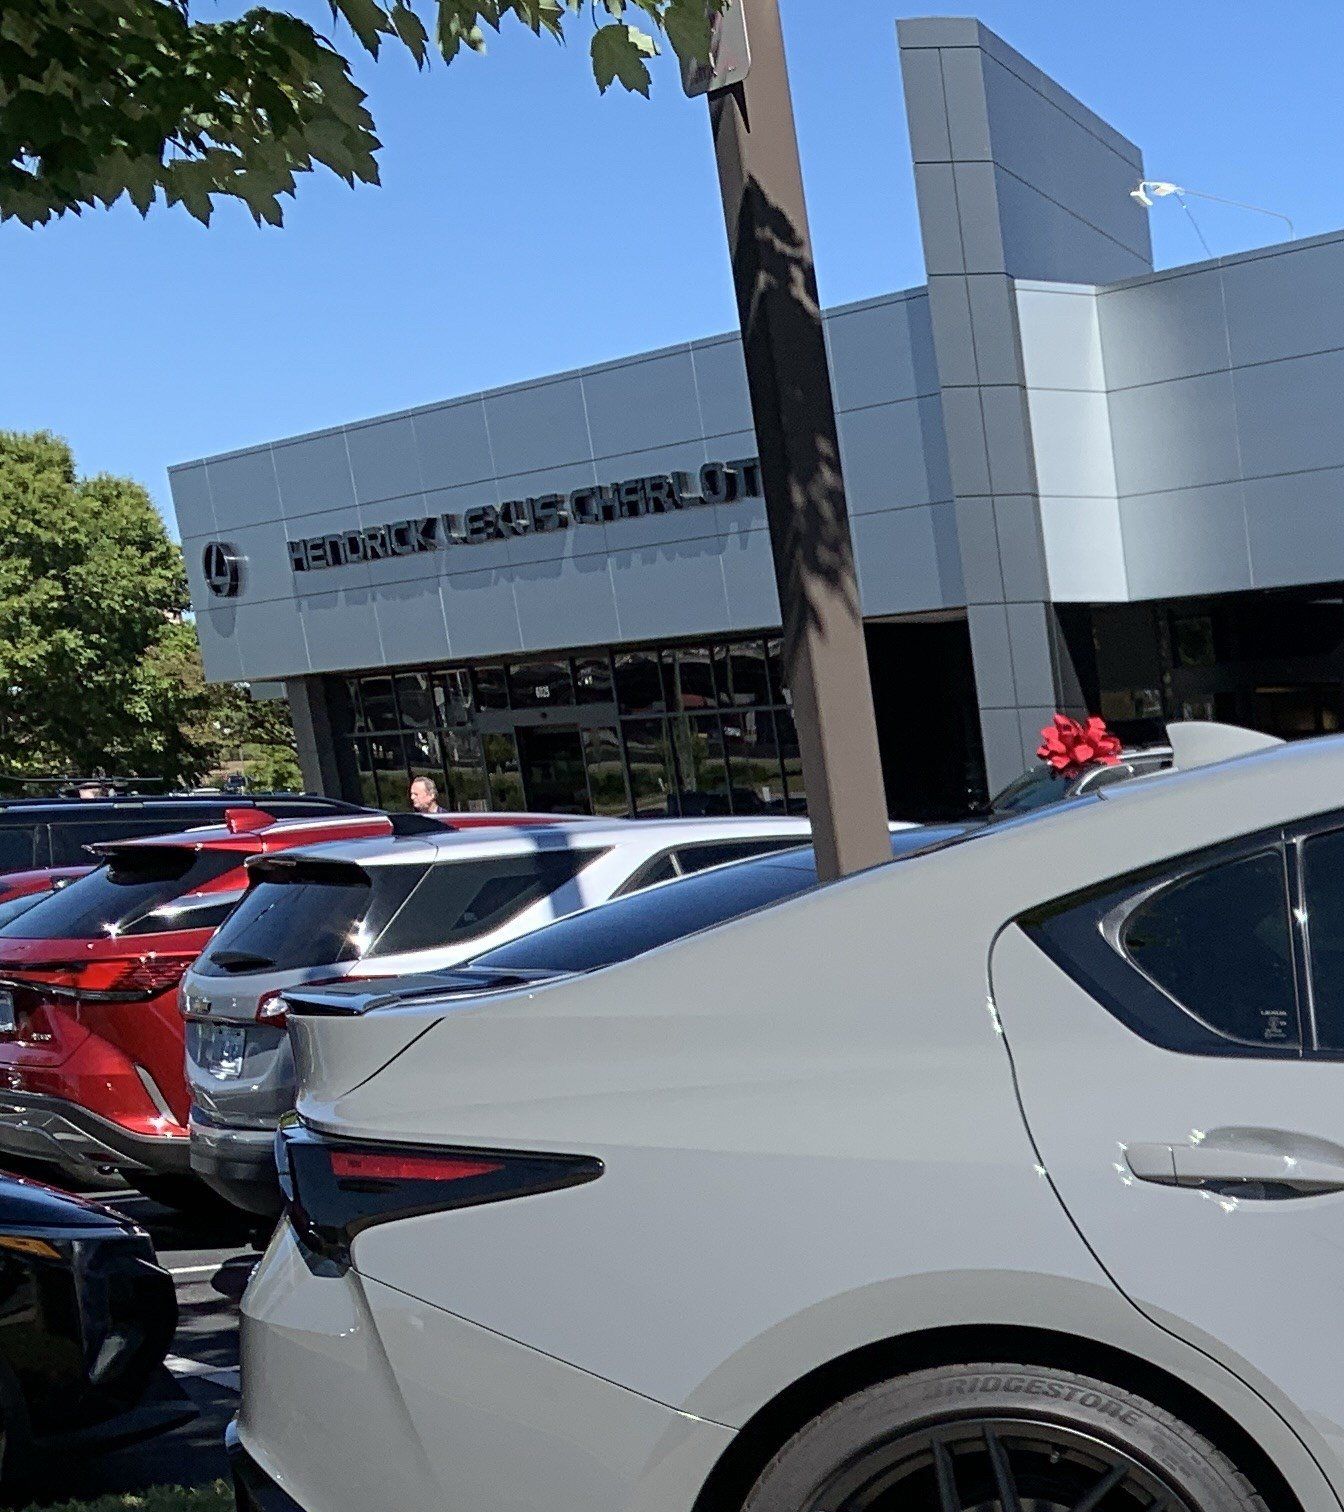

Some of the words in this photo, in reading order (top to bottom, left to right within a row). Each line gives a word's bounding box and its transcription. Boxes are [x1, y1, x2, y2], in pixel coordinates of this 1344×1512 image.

[287, 517, 443, 571] HENDRICK
[441, 493, 569, 545] LEXUS
[570, 456, 763, 524] CHARLOTT
